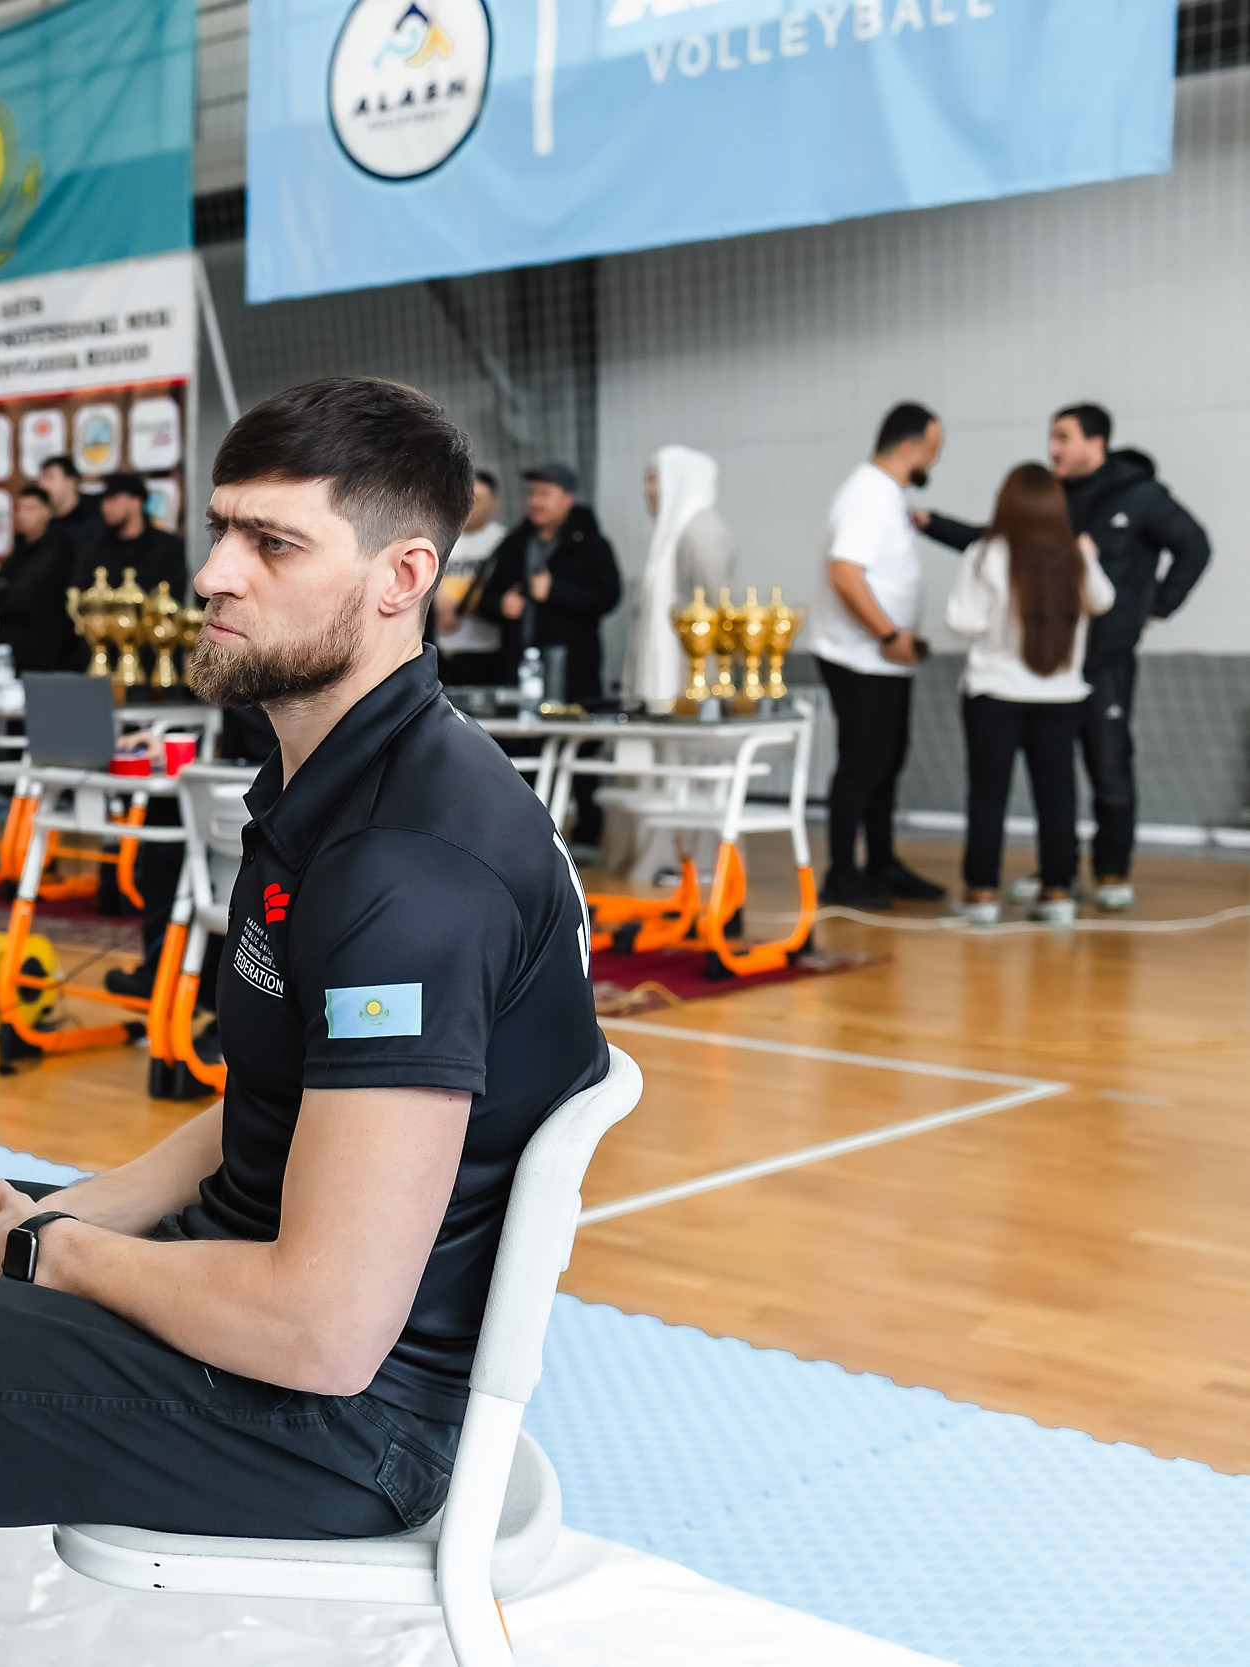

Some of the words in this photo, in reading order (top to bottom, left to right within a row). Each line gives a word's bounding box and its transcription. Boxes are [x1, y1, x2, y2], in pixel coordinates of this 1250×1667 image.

[352, 76, 466, 117] ALASH
[243, 925, 260, 945] PUBLIC
[234, 948, 285, 994] FEDERATION
